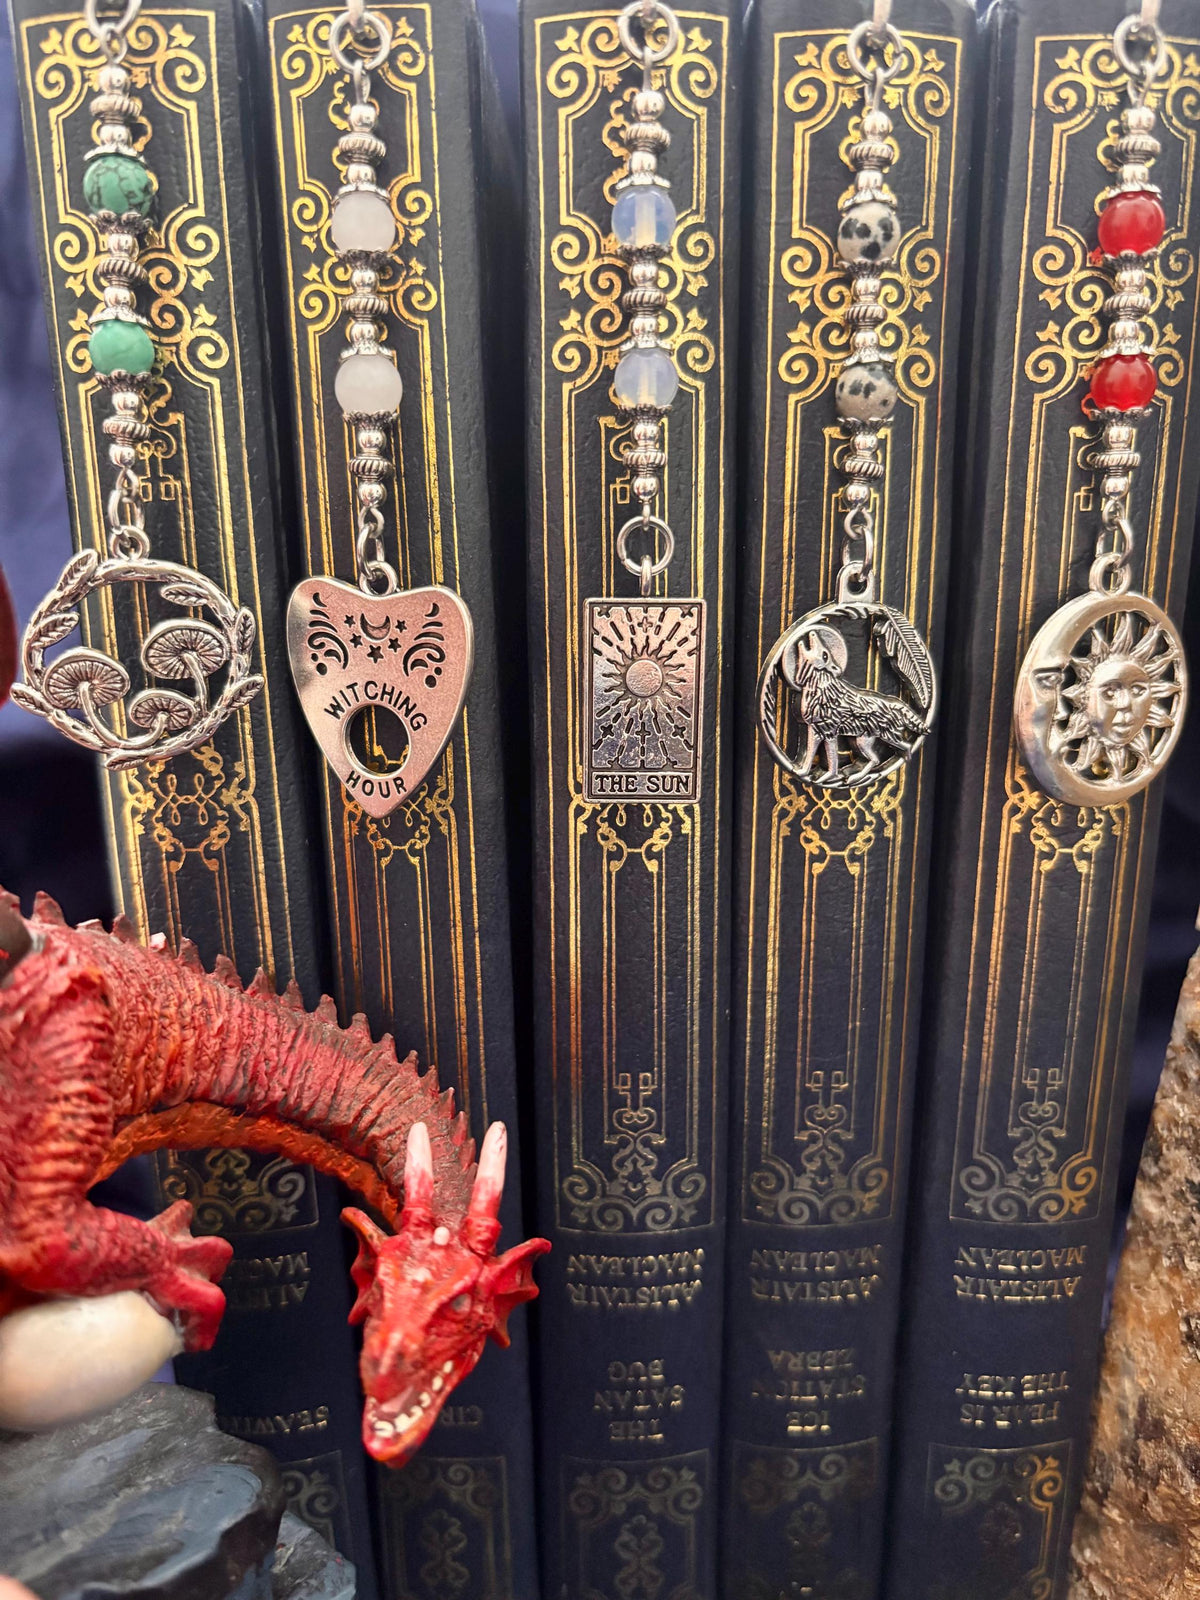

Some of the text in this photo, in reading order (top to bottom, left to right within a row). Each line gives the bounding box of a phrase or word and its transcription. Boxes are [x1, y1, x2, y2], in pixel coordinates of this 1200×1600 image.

[324, 680, 427, 732] WITCHING
[346, 770, 407, 798] HOUR
[595, 775, 690, 793] THE SUN
[566, 1248, 705, 1276] MACLEAN
[750, 1244, 883, 1273] MACLEAN
[954, 1245, 1087, 1274] MACLEAN
[566, 1279, 702, 1310] ALISTAIR
[751, 1274, 880, 1302] ALISTAIR
[953, 1275, 1083, 1303] ALISTAIR
[608, 1359, 665, 1382] BUG
[767, 1349, 855, 1372] ZEBRA
[593, 1385, 686, 1412] SATAN
[955, 1371, 1070, 1399] THE KEY
[786, 1410, 831, 1436] ICE
[960, 1401, 1061, 1429] FEAR IS
[609, 1419, 664, 1442] THE
